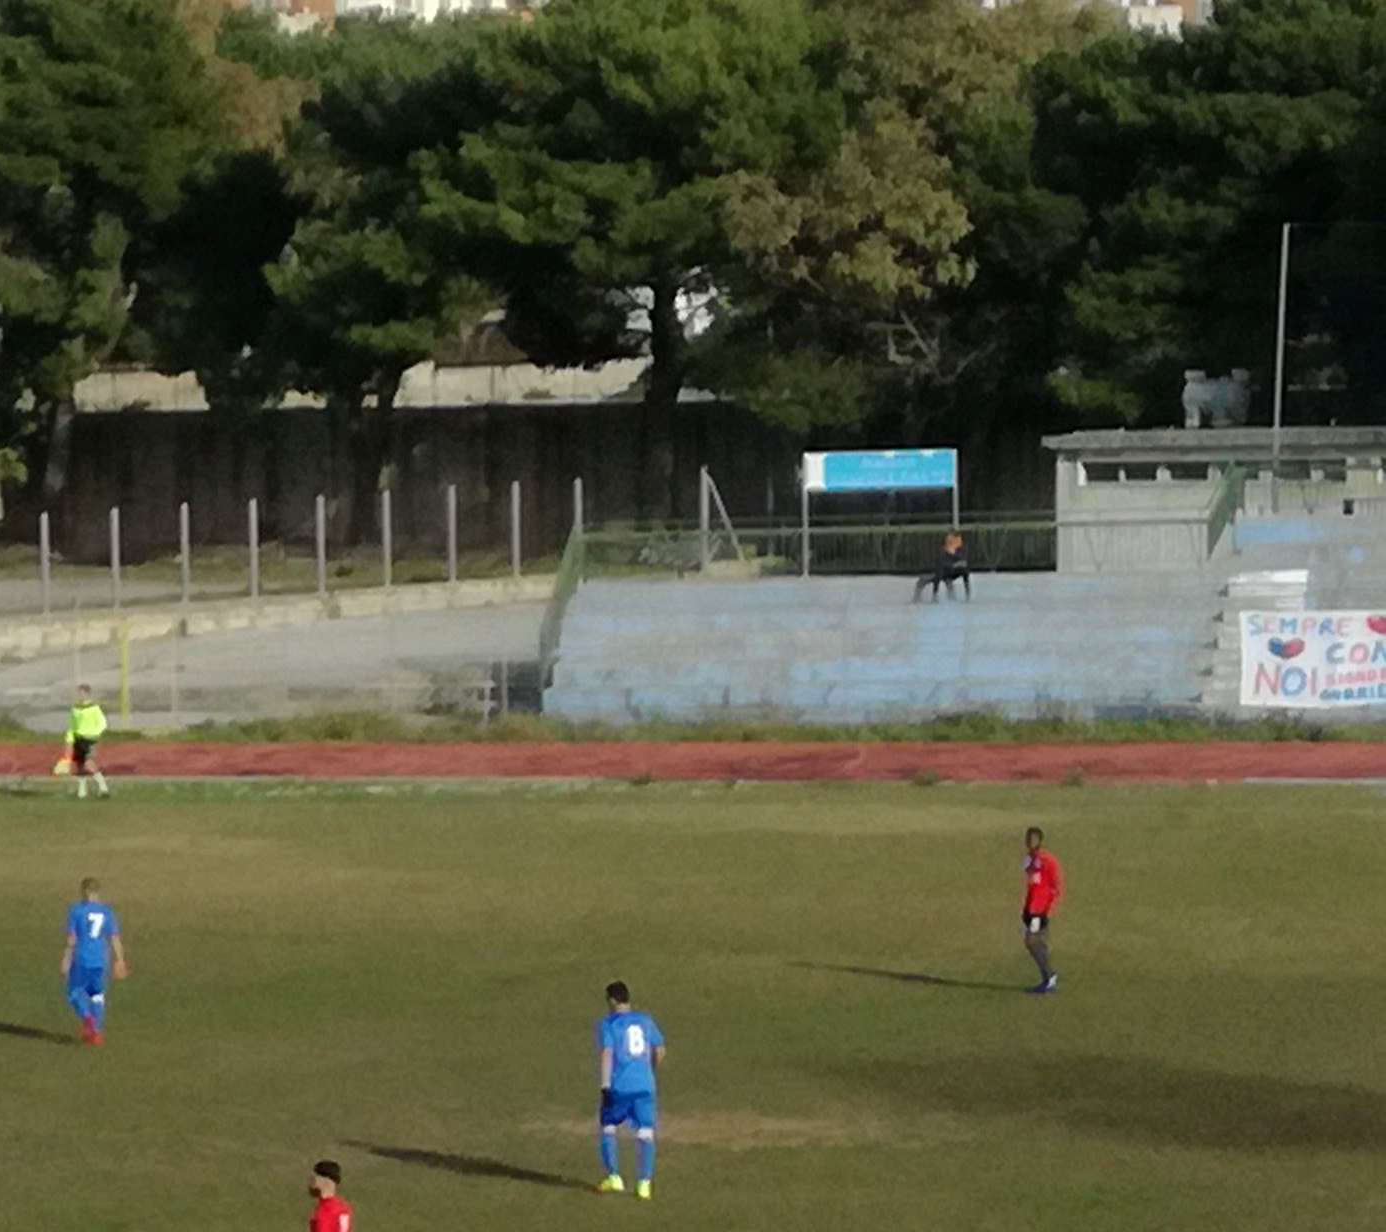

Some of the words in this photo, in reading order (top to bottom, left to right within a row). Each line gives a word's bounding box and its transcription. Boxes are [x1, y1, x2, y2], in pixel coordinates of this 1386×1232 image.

[1247, 613, 1354, 637] SEMPRE
[1253, 662, 1319, 697] NOI
[87, 911, 105, 939] 7
